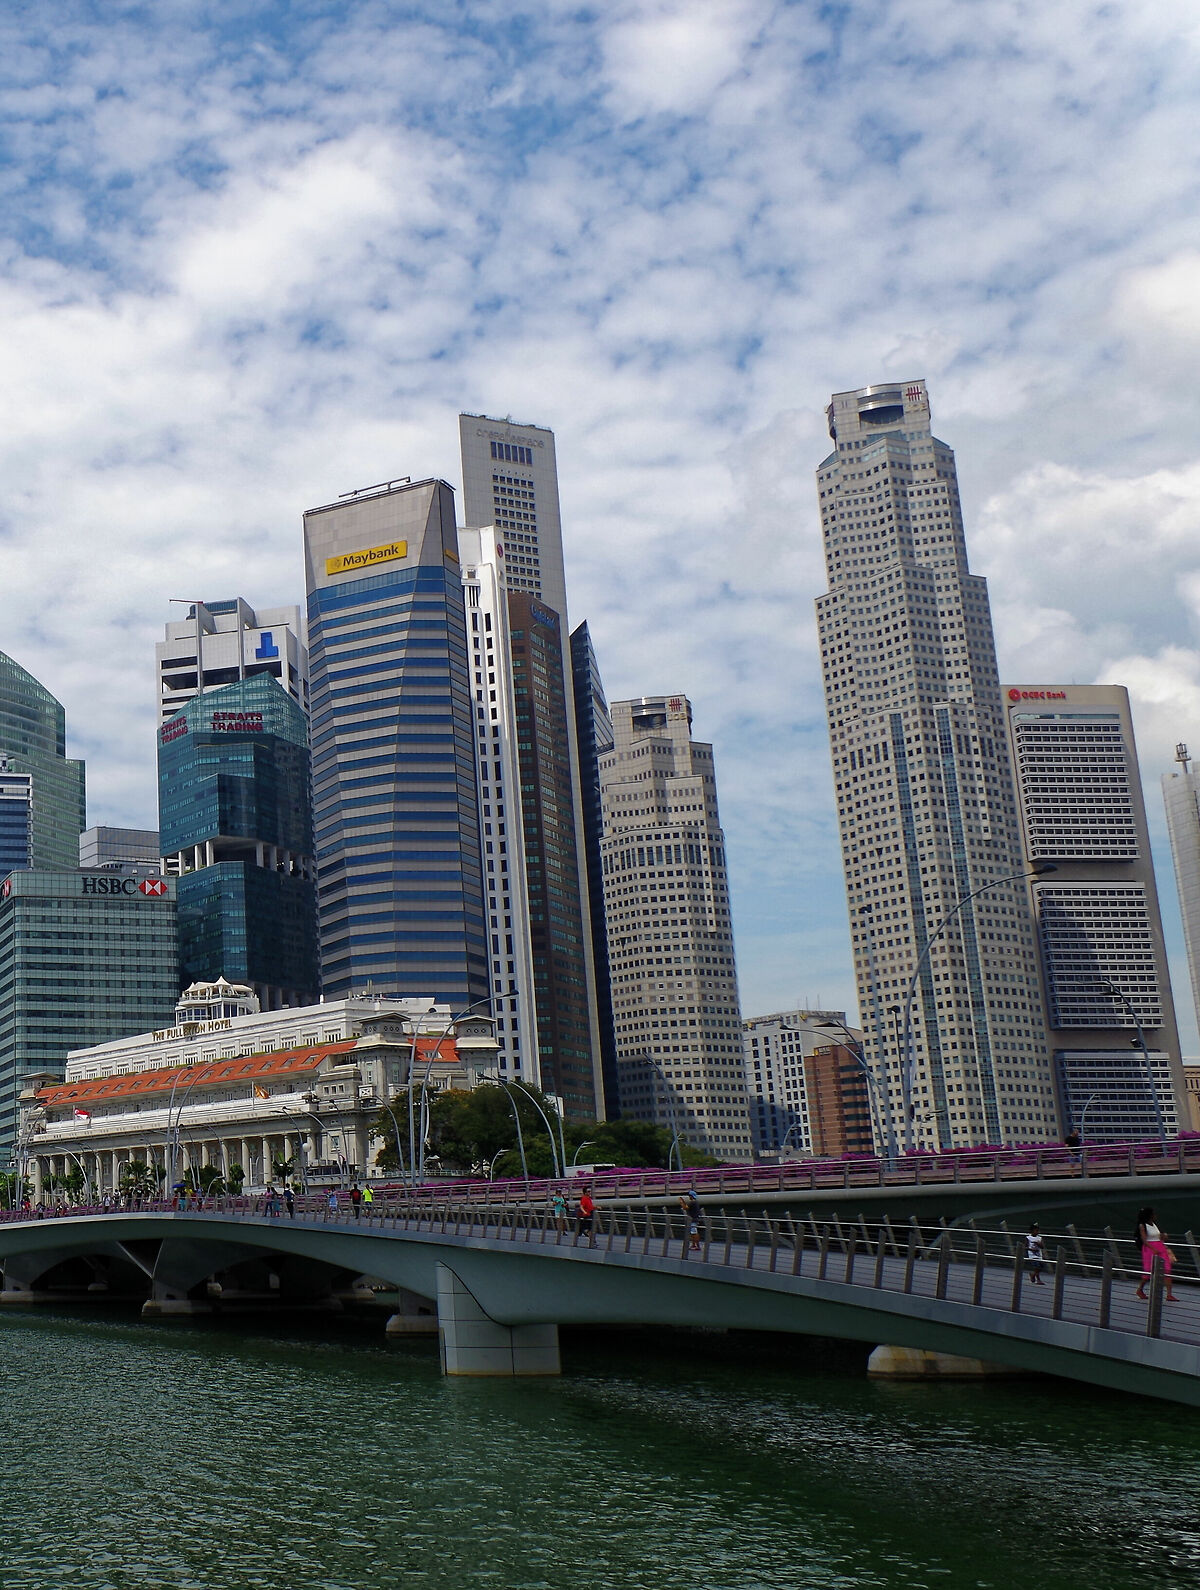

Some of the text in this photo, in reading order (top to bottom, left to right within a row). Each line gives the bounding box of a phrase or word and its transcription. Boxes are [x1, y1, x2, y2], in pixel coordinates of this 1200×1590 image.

[343, 545, 399, 567] Maybank
[1021, 691, 1066, 700] OCBC Bank
[161, 716, 187, 735] STRAITS
[213, 711, 262, 721] STRAITS
[161, 725, 188, 745] TRADING
[211, 722, 263, 732] TRADING
[81, 877, 137, 896] HSBC
[152, 1019, 233, 1041] THE FULLERTON HOTEL
